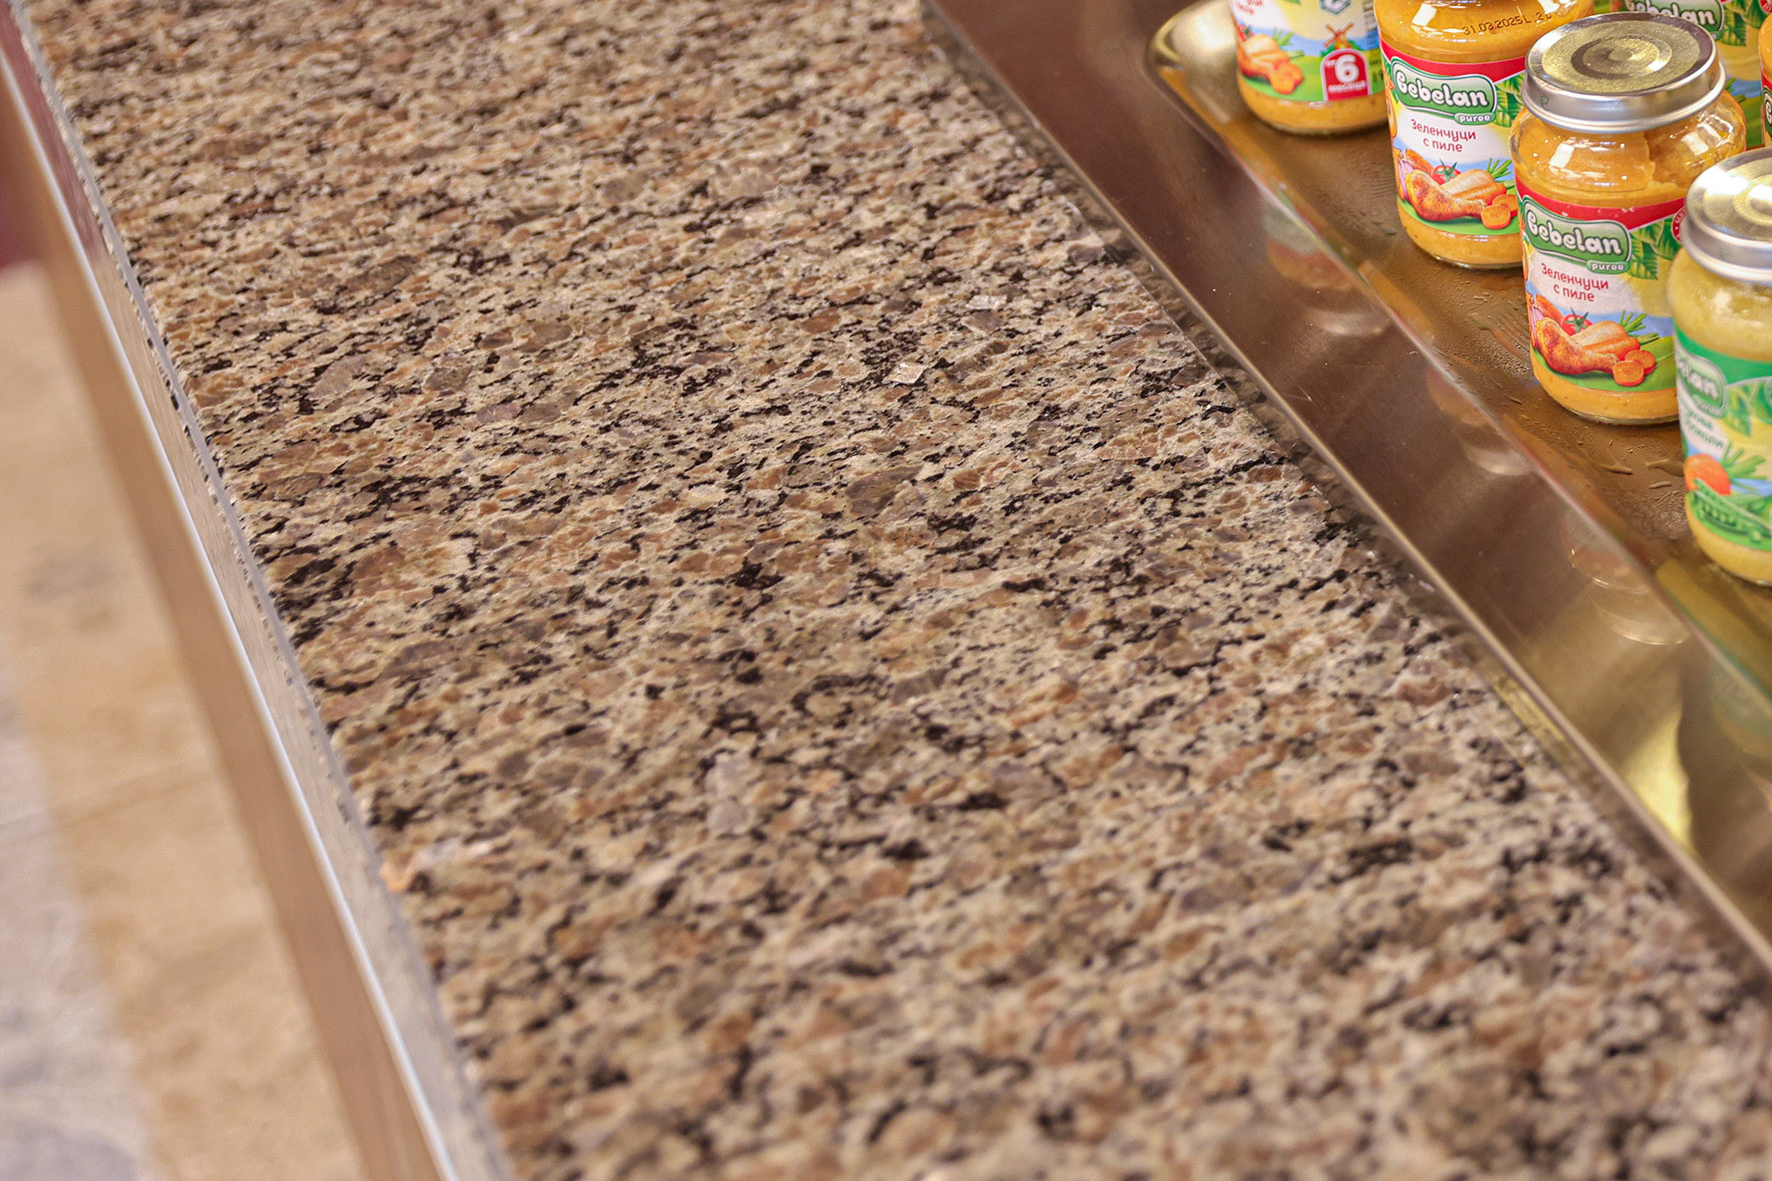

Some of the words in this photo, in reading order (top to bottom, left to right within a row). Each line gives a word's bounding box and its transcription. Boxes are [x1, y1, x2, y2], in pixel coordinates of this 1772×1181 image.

[1463, 15, 1524, 36] 31.03.2025
[1334, 55, 1360, 84] 6
[1395, 69, 1489, 107] Bebelan
[1411, 118, 1477, 141] Зеленчуци
[1459, 114, 1491, 124] puree
[1432, 139, 1463, 152] пиле
[1526, 209, 1623, 256] Bebelan
[1541, 262, 1609, 291] Зеленчуци
[1591, 262, 1625, 272] puree
[1553, 283, 1561, 294] с
[1563, 285, 1595, 302] пиле
